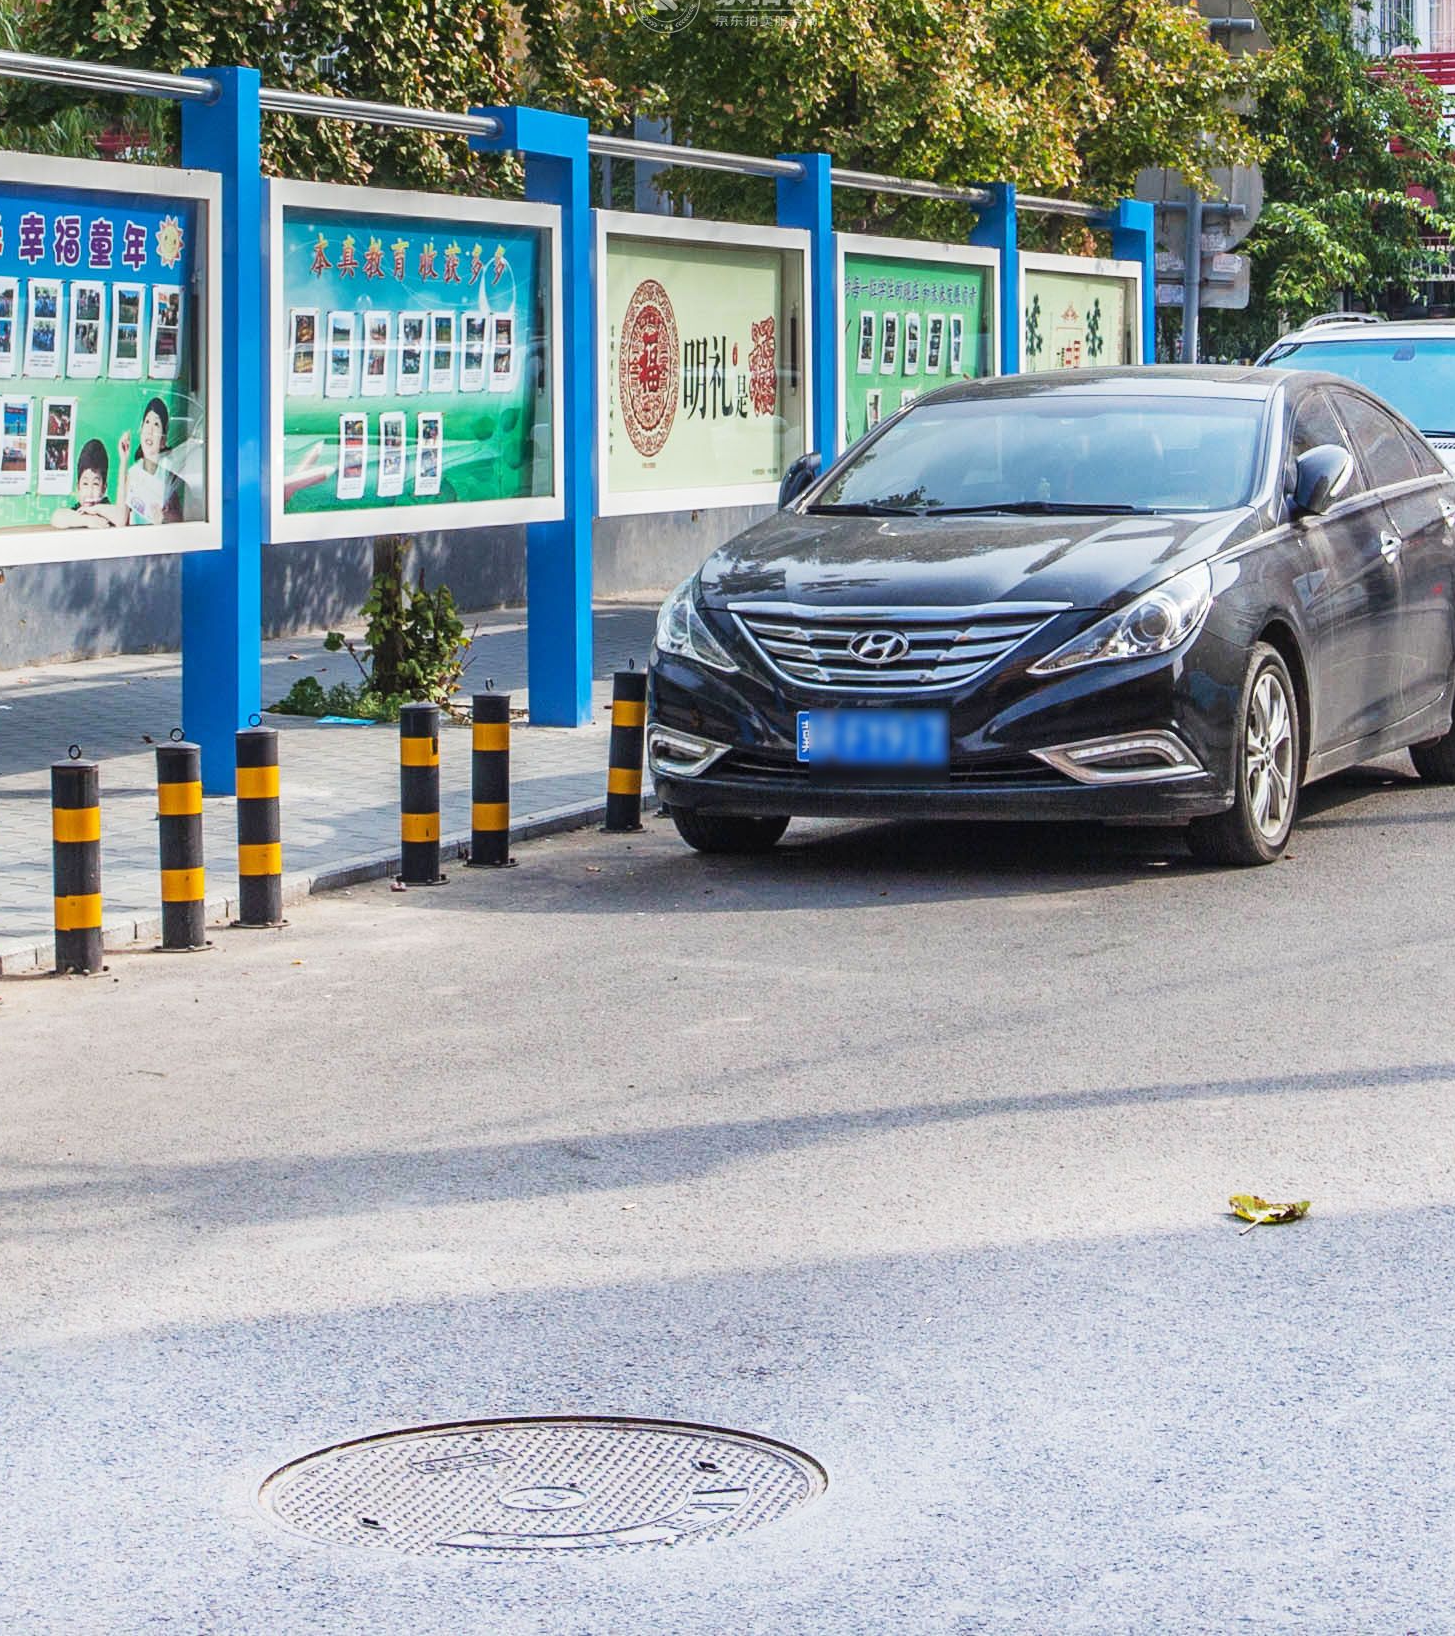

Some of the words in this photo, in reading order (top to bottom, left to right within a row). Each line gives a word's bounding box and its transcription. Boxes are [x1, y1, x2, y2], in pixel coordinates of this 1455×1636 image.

[18, 212, 148, 271] 幸福童年
[309, 232, 409, 280] 本真教育
[418, 240, 506, 286] 收获多多
